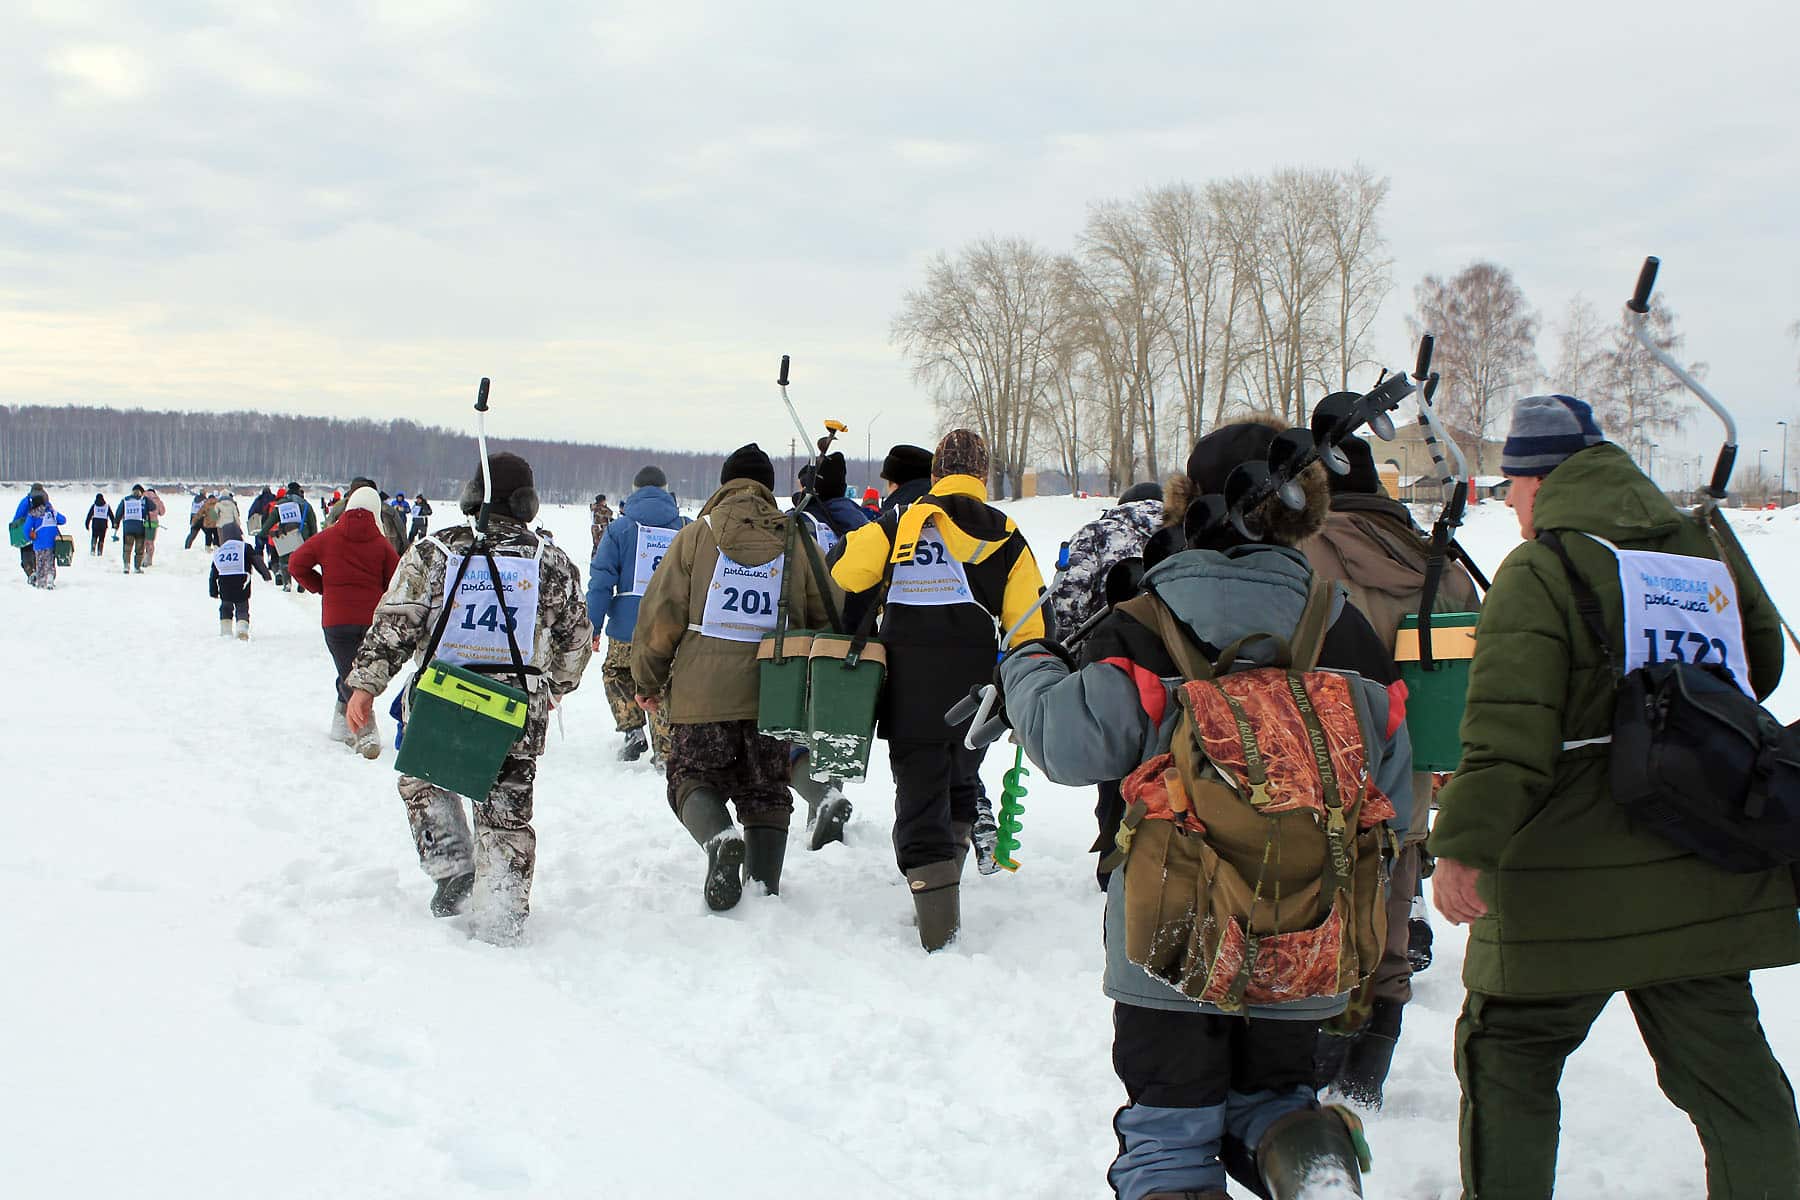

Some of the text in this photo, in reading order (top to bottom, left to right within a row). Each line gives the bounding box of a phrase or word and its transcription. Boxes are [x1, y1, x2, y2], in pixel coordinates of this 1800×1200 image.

[219, 552, 240, 562] 242
[900, 540, 948, 566] 52
[723, 566, 768, 579] рыбалка
[721, 587, 772, 615] 201
[461, 603, 519, 633] 143
[1288, 676, 1312, 713] AQUATIC
[1239, 720, 1260, 767] AQUATIC
[1310, 728, 1333, 784] AQUATIC
